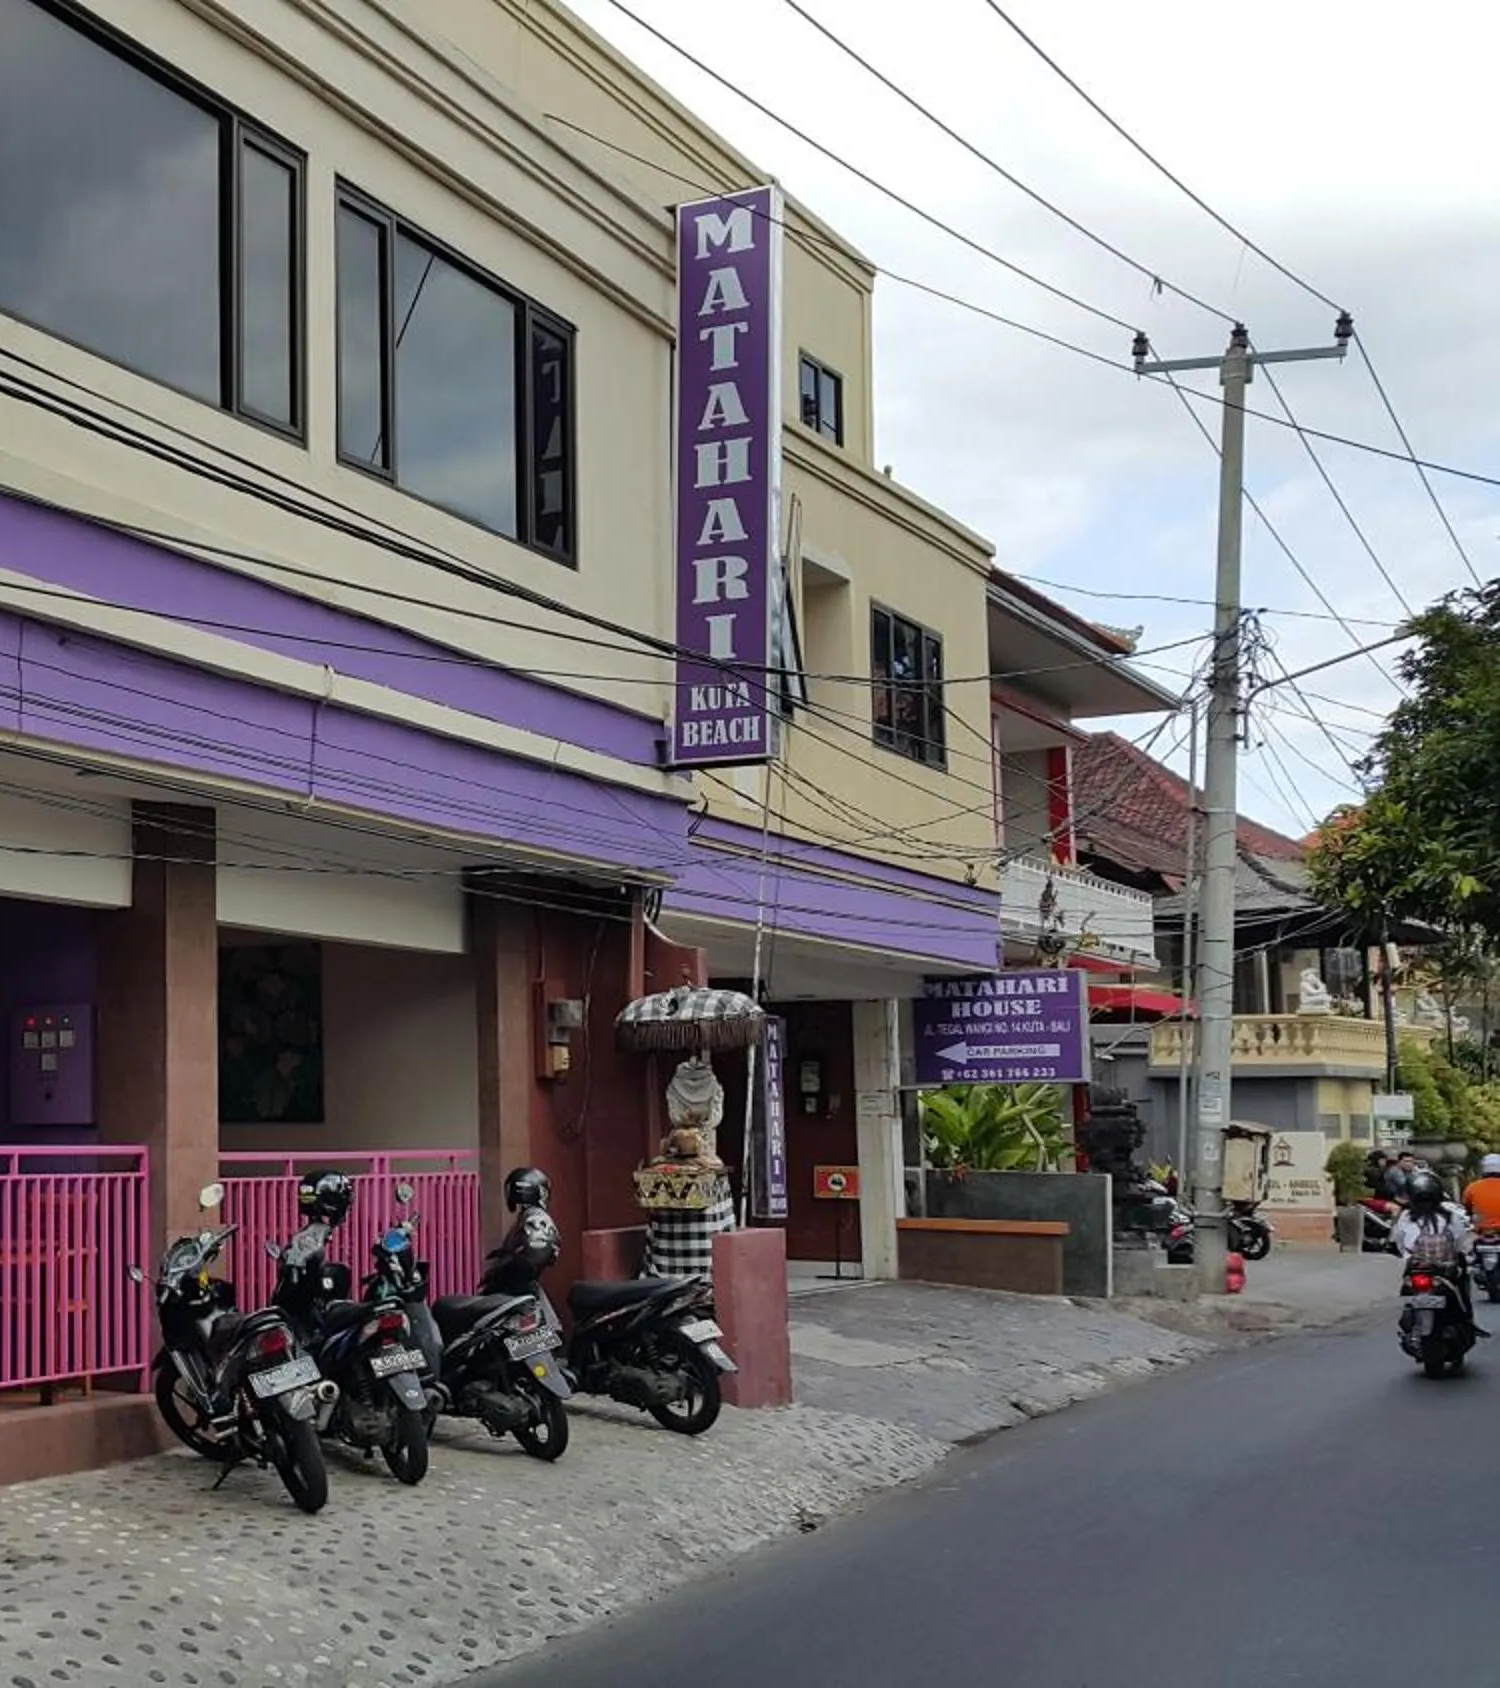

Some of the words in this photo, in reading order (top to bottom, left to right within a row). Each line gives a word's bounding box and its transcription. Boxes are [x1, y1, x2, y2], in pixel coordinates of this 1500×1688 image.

[693, 203, 756, 662] MATAHARI
[681, 715, 761, 747] BEACH
[951, 999, 1044, 1018] HOUSE
[967, 1046, 990, 1057] CAR
